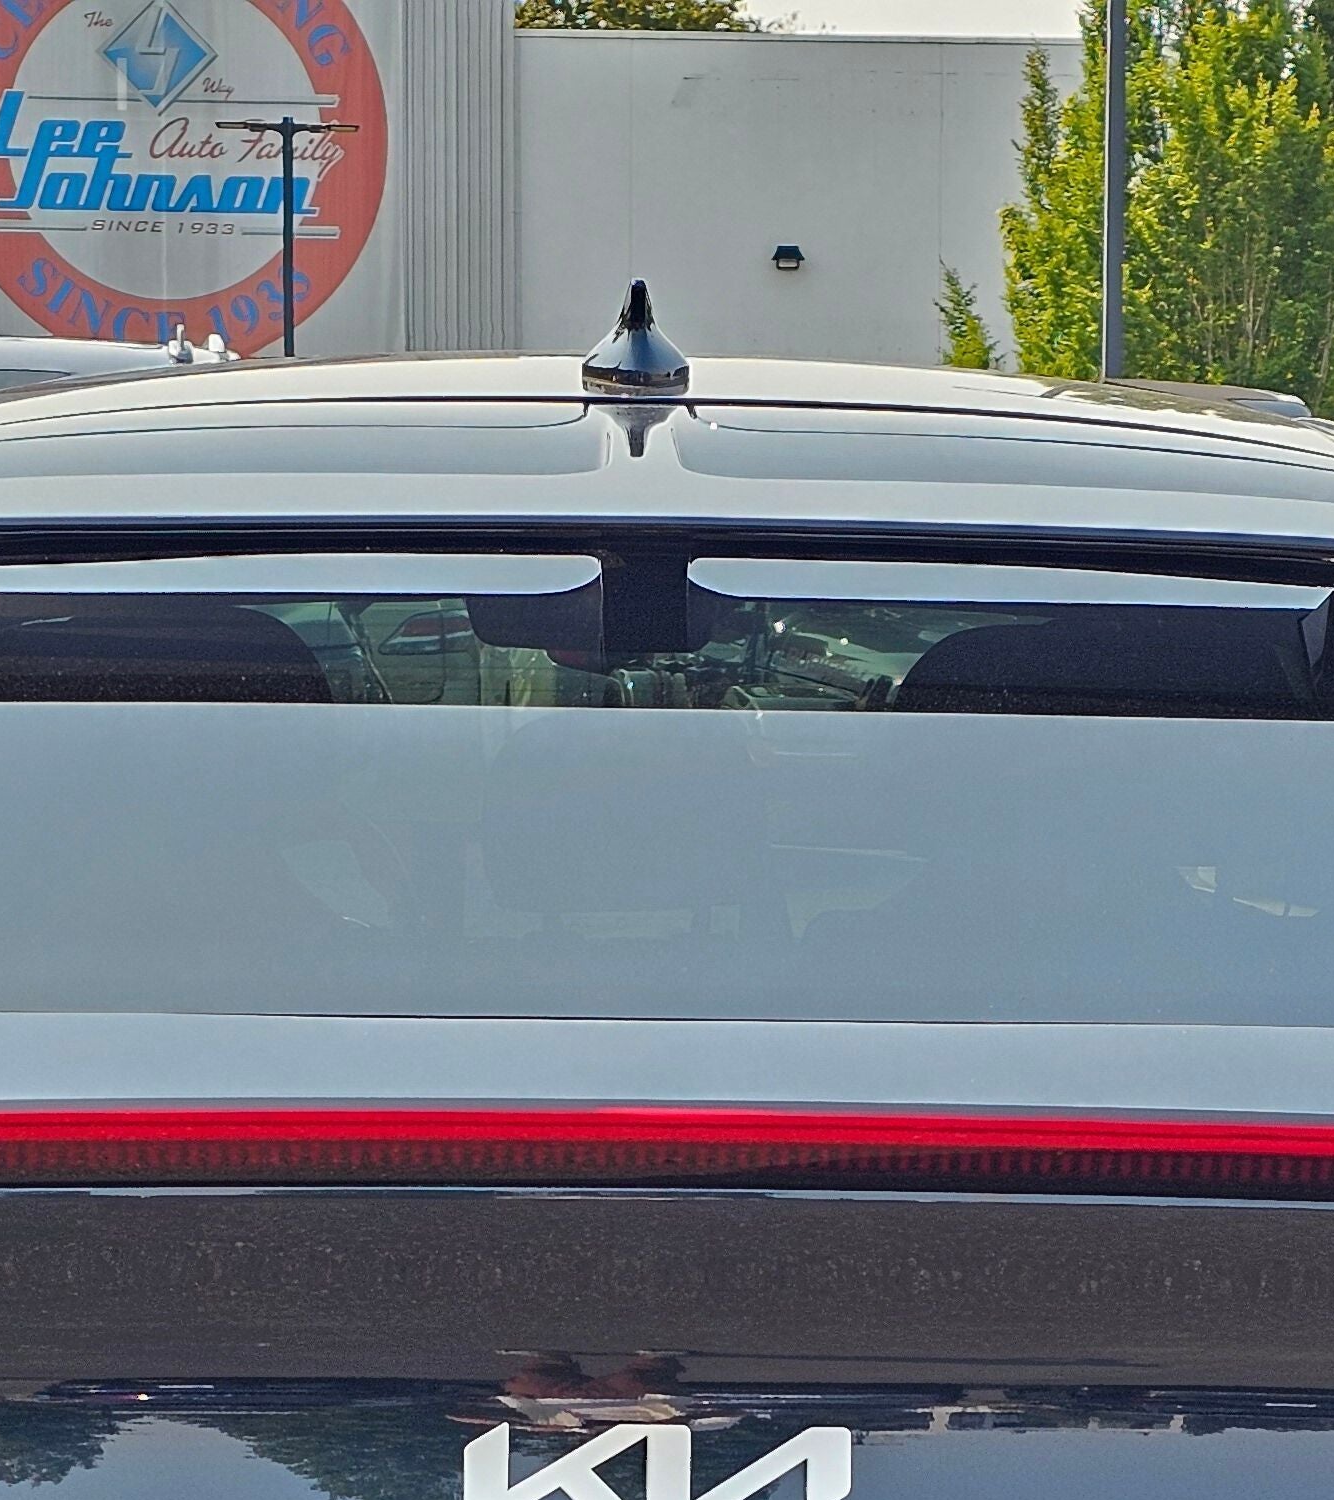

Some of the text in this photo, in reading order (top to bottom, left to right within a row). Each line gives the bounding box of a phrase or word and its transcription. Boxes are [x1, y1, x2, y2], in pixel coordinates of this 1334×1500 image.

[83, 11, 114, 28] The
[202, 77, 235, 98] Way
[149, 116, 345, 178] Auto Faily
[91, 219, 235, 236] SINCE 1933
